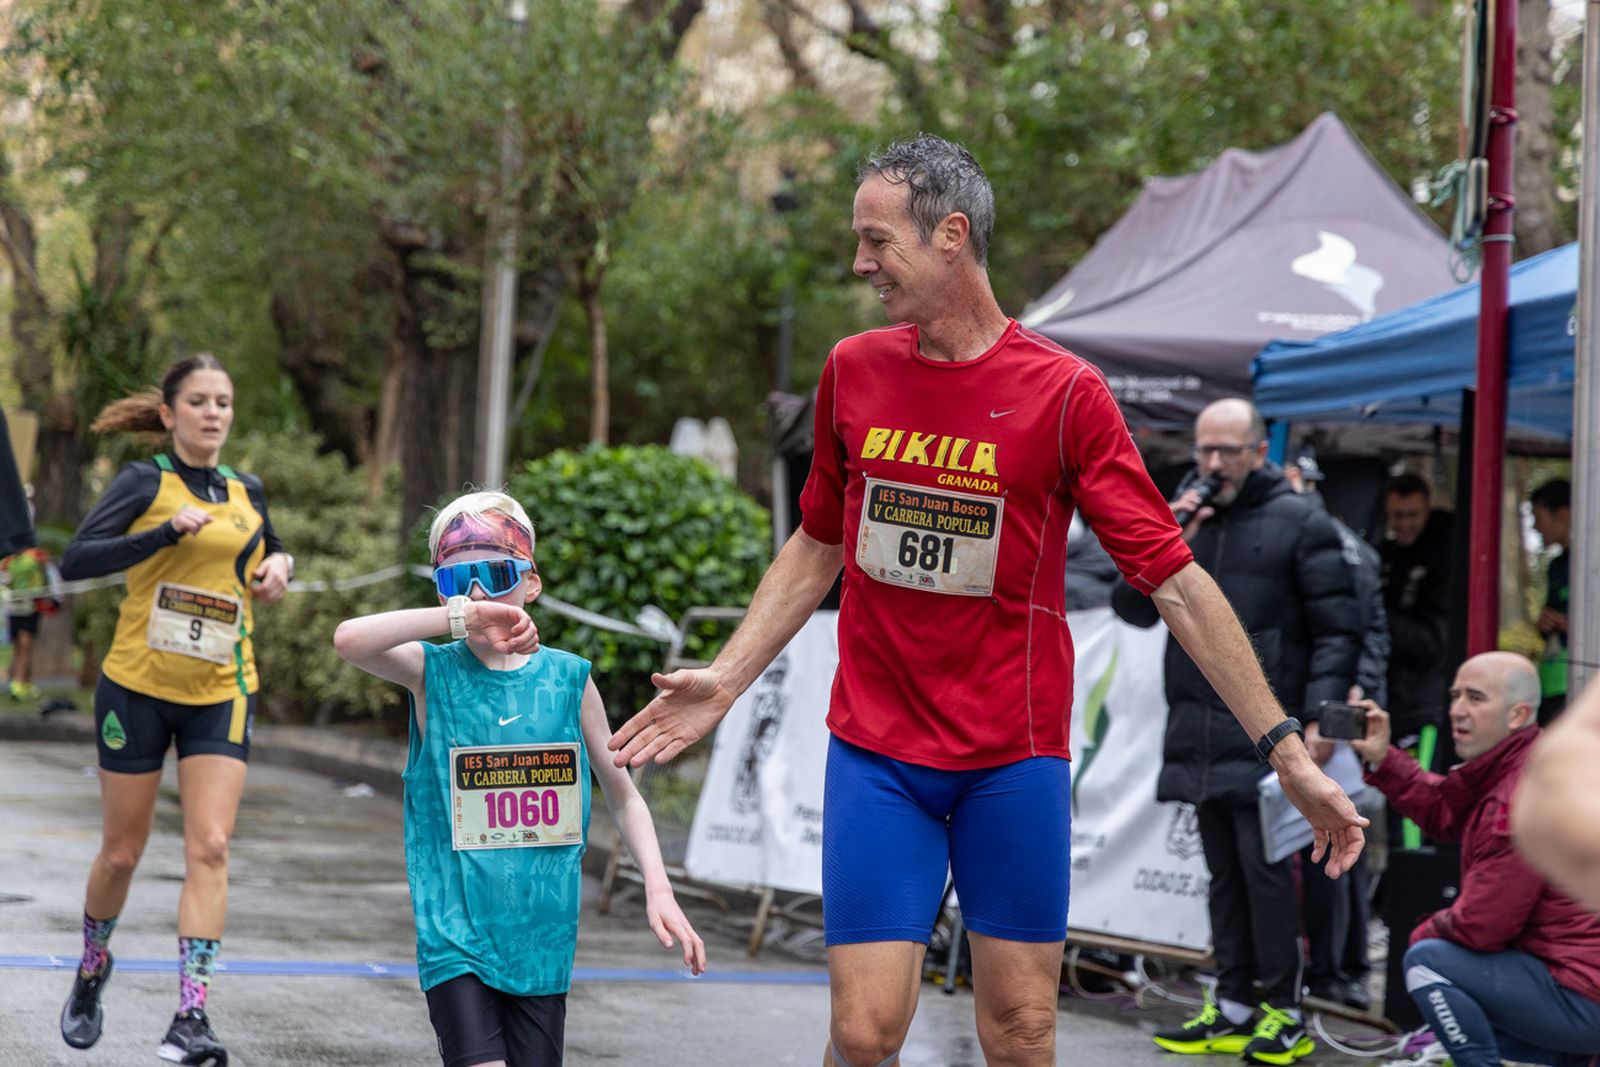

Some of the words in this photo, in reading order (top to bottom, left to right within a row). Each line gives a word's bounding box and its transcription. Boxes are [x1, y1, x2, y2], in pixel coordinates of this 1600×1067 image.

[860, 427, 999, 476] BIKILA
[938, 474, 998, 493] GRANADA
[879, 488, 896, 502] IES
[899, 493, 919, 506] San
[922, 496, 948, 512] Juan
[952, 501, 988, 516] Bosco
[874, 504, 882, 518] V
[884, 507, 932, 527] CARRERA
[937, 514, 990, 536] POPULAR
[898, 530, 954, 574] 681
[189, 619, 202, 640] 9
[464, 756, 482, 769] IES
[486, 755, 509, 768] San
[512, 753, 540, 766] Juan
[543, 752, 569, 765] Bosco
[462, 773, 470, 786] V
[474, 770, 527, 786] CARRERA
[531, 768, 574, 783] POPULAR
[485, 789, 560, 828] 1060
